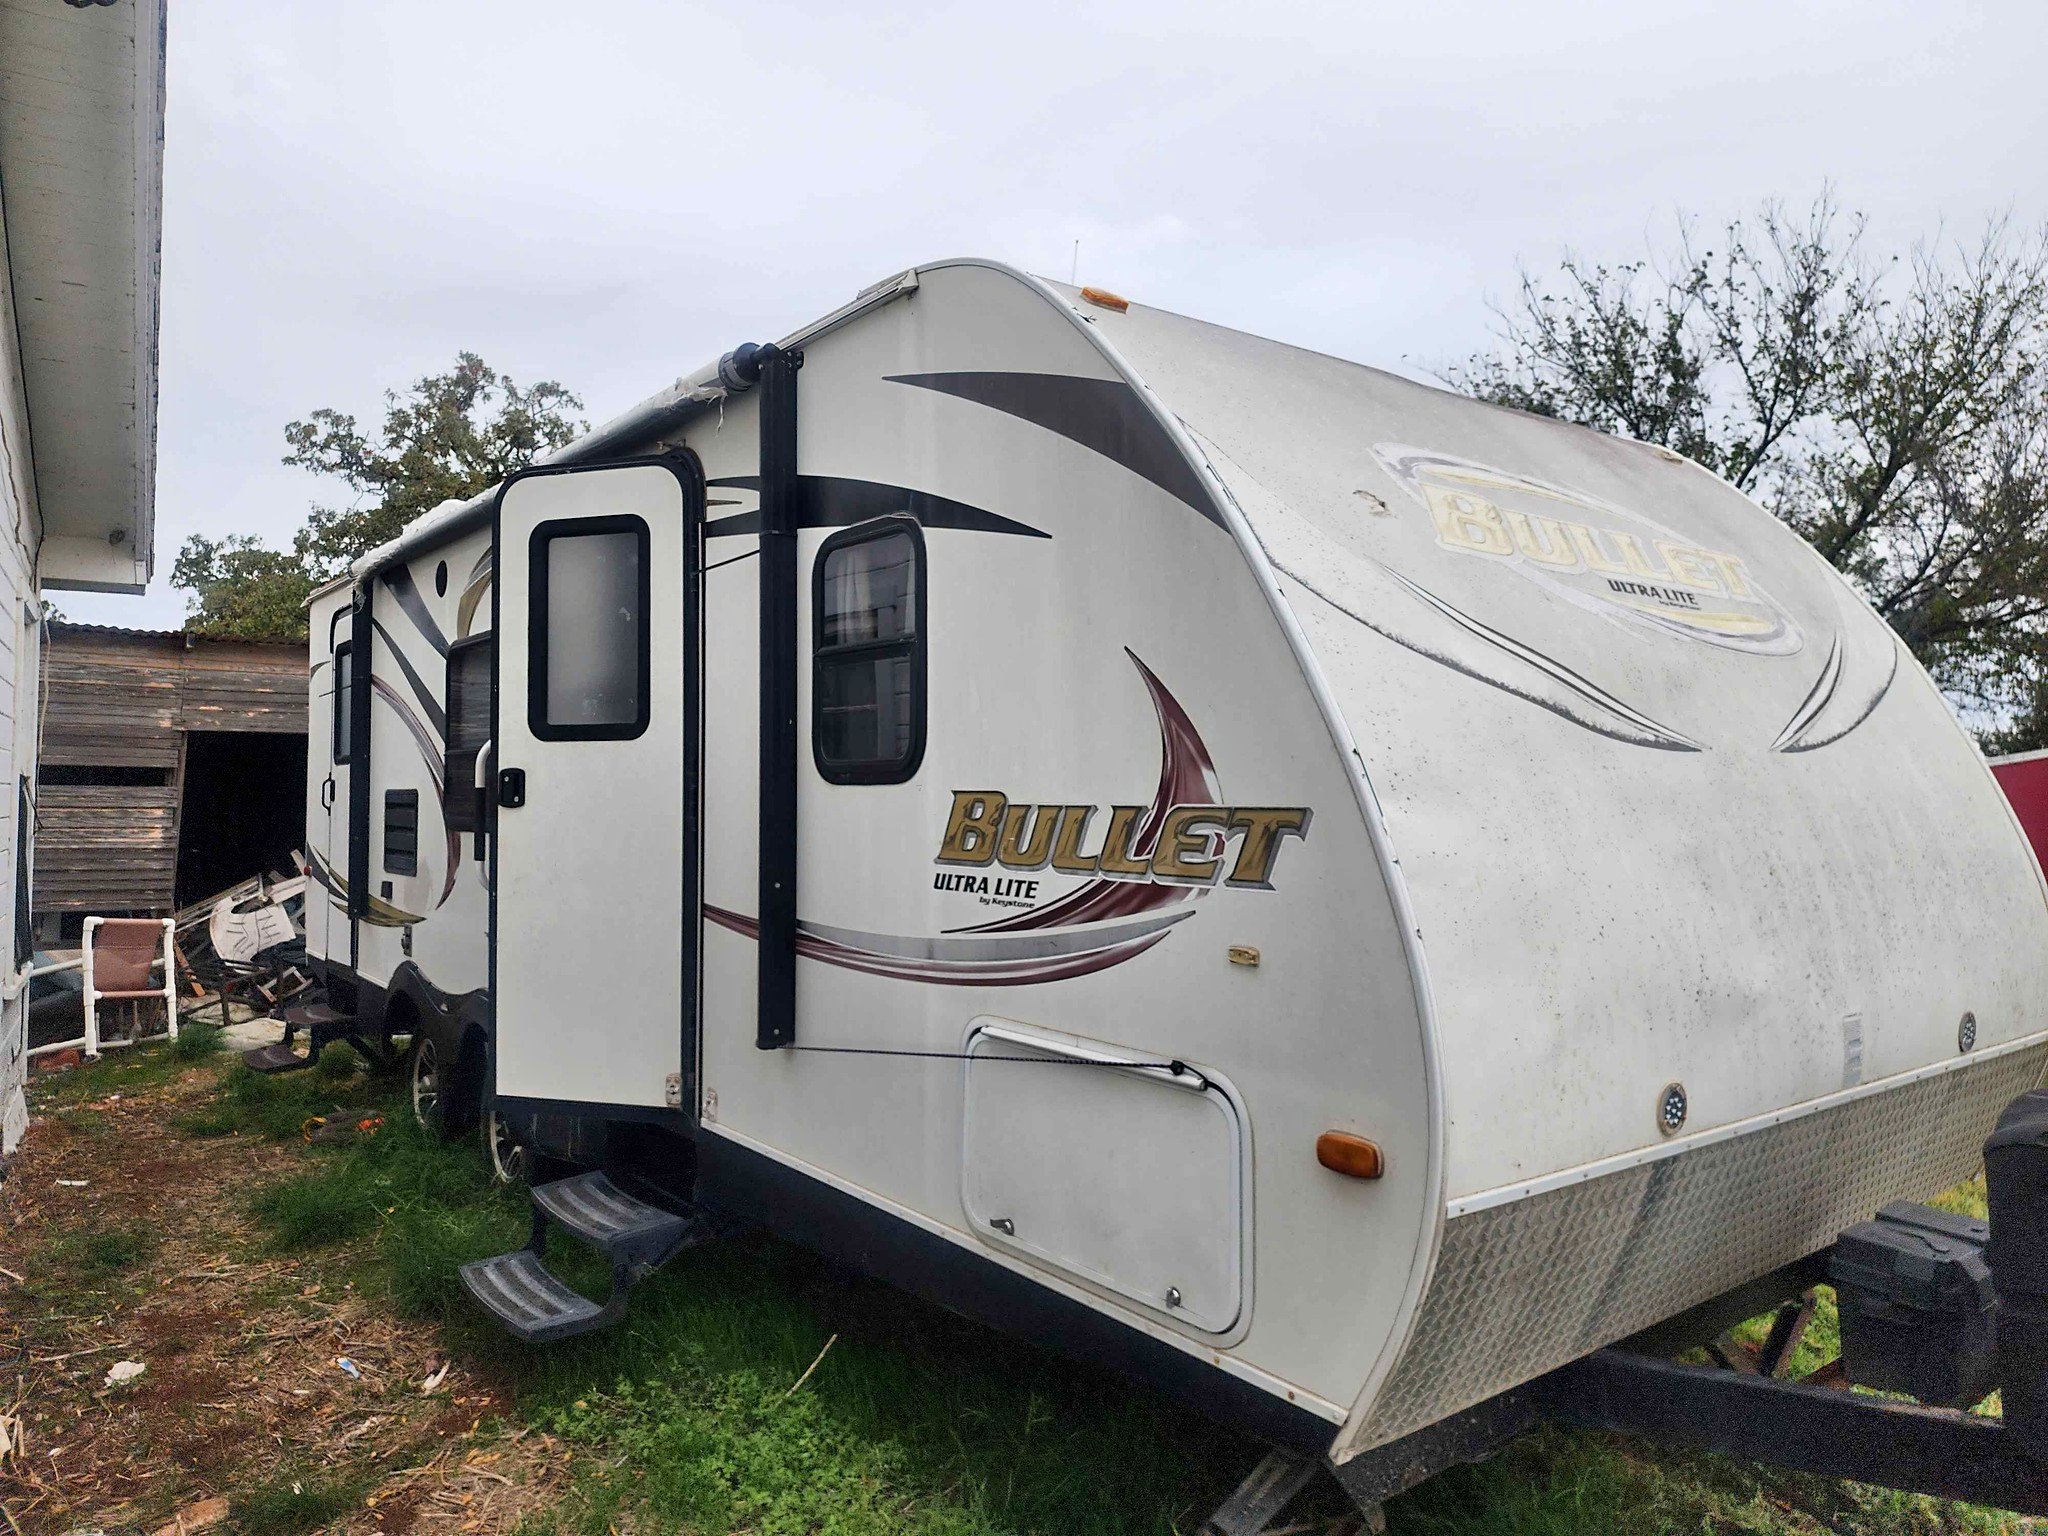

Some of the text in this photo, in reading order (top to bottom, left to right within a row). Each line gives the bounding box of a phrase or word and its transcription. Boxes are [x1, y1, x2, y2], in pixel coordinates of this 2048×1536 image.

[1420, 483, 1754, 598] BULLET
[1607, 579, 1661, 598] ULTRA
[1663, 588, 1698, 605] LITE
[934, 790, 1314, 891] BULLET
[933, 873, 1039, 899] ULTRA LITE
[979, 897, 1035, 908] by Keystone
